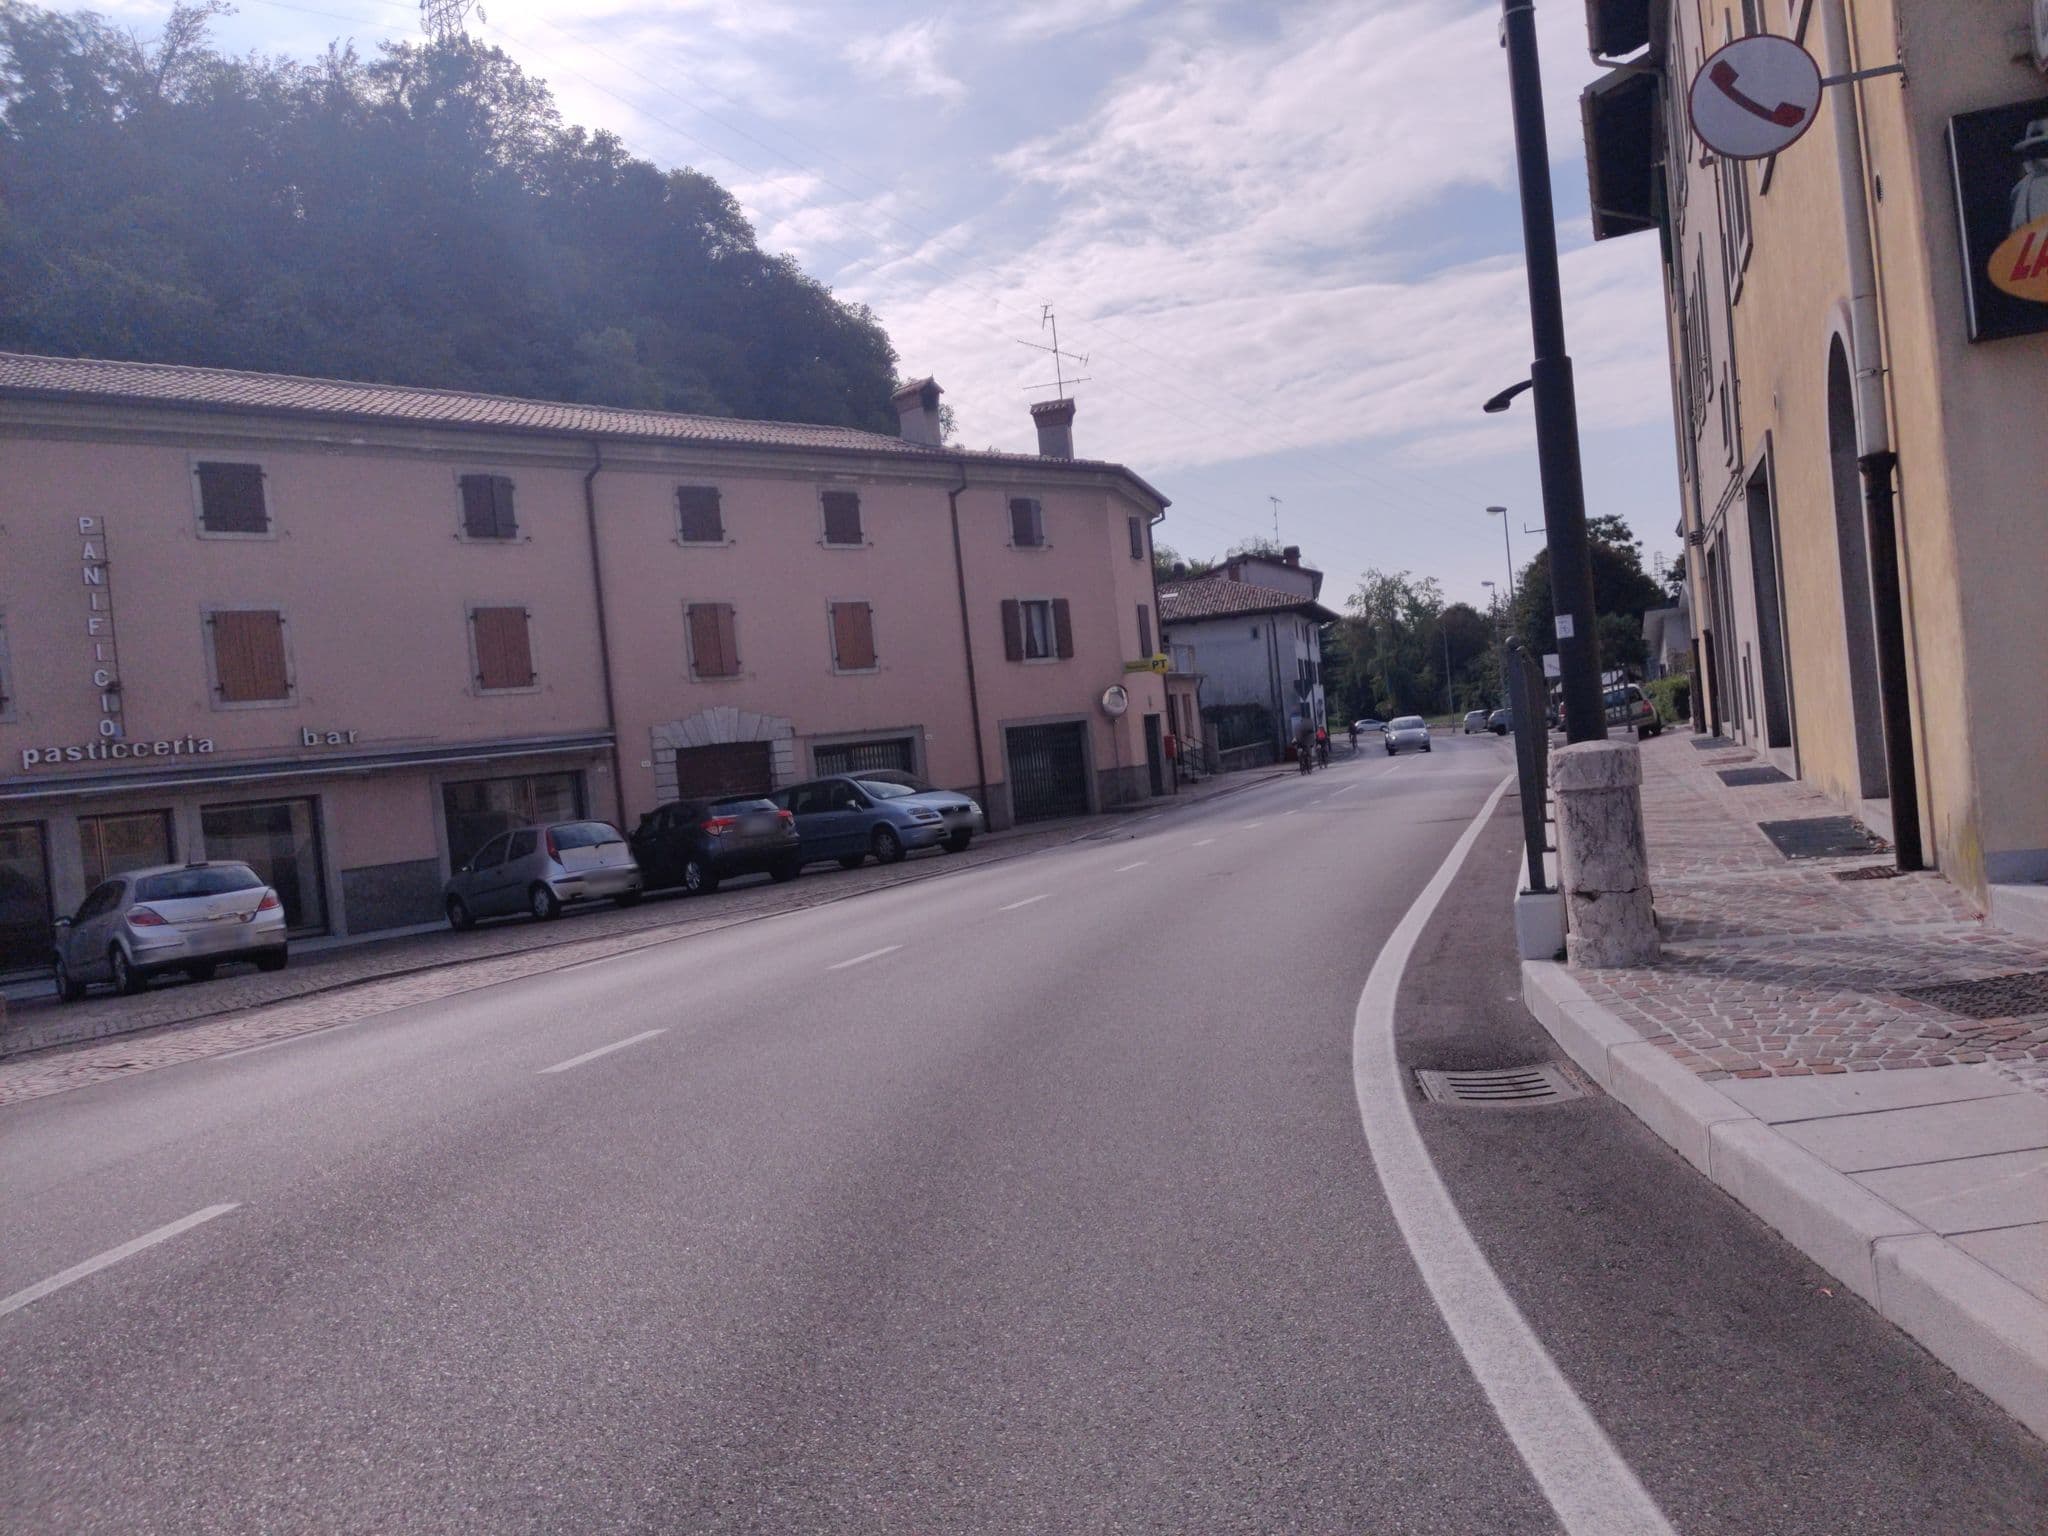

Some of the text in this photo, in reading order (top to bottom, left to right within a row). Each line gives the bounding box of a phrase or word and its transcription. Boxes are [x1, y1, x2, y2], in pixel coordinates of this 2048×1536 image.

[78, 517, 115, 736] PANIFICIO
[1151, 658, 1168, 670] PT
[23, 727, 358, 769] pasticceria bar
